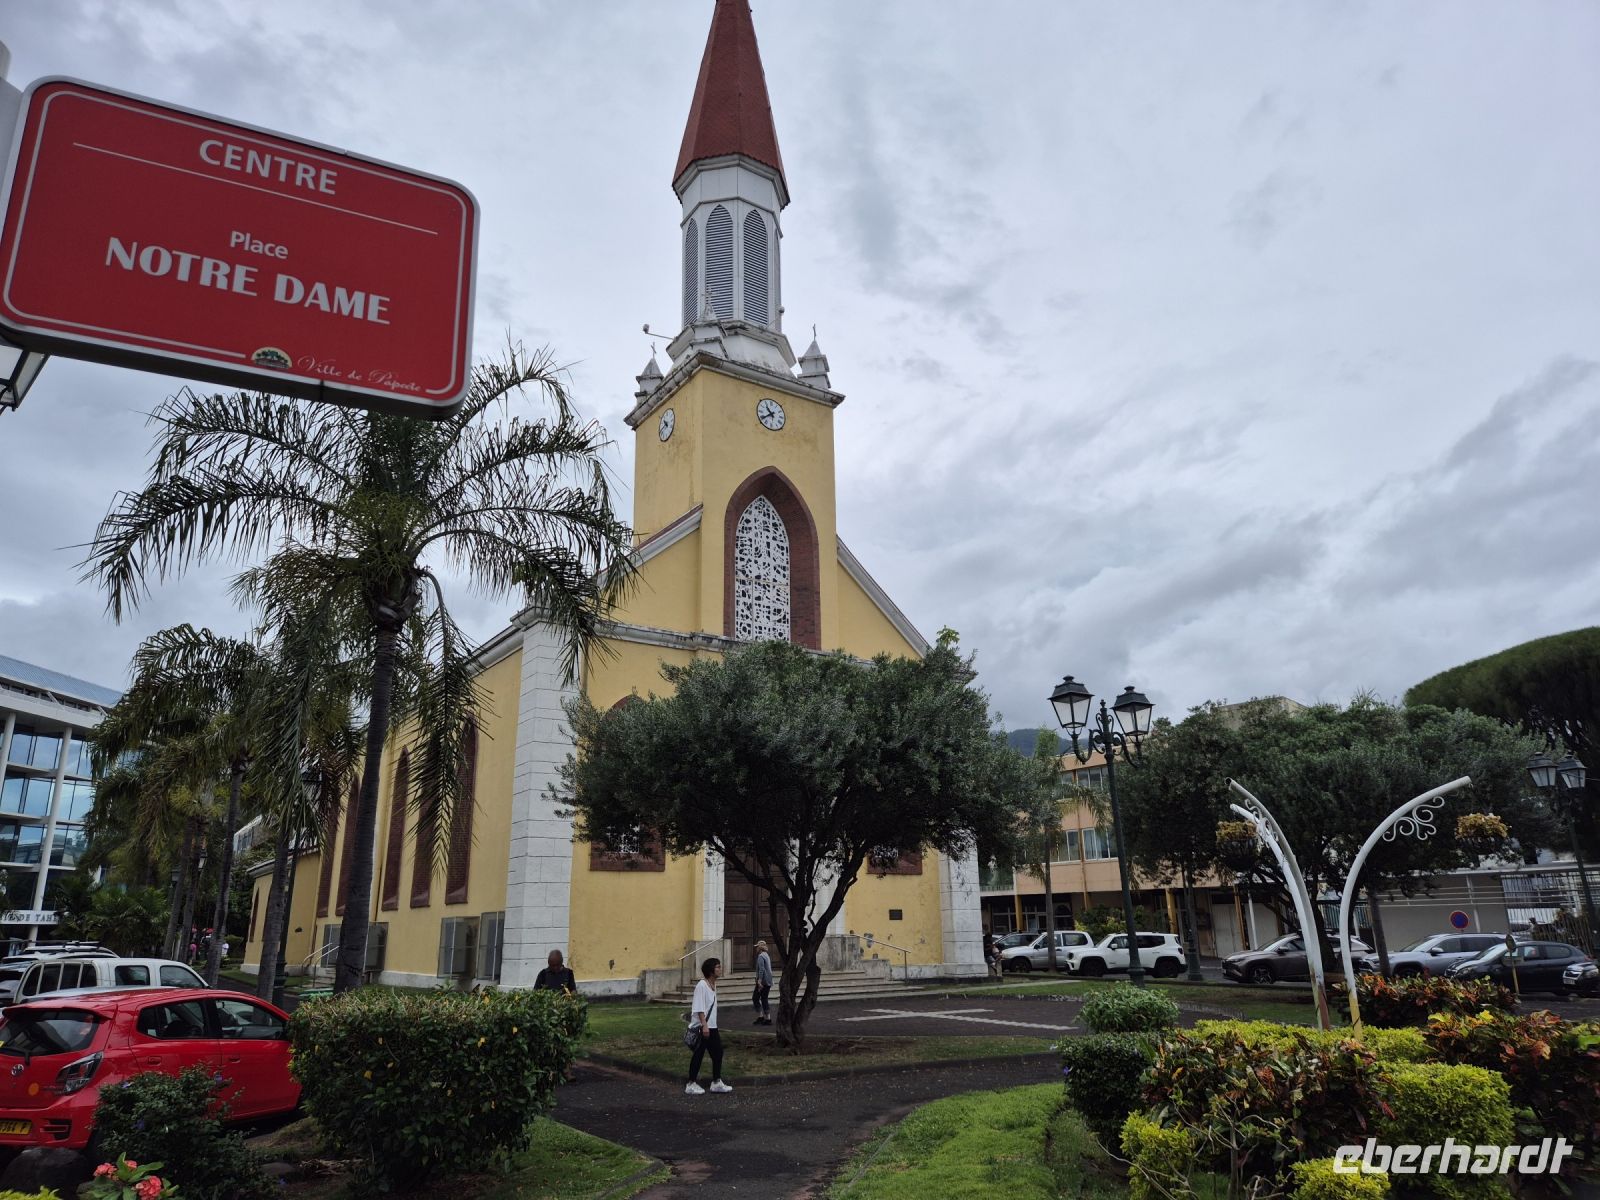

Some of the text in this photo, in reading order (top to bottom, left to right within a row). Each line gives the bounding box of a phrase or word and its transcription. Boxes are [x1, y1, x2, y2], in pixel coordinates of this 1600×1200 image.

[199, 139, 338, 195] CENTRE
[229, 230, 289, 259] Place
[105, 236, 390, 325] NOTRE DAME
[298, 356, 341, 376] Ville
[347, 370, 362, 380] de
